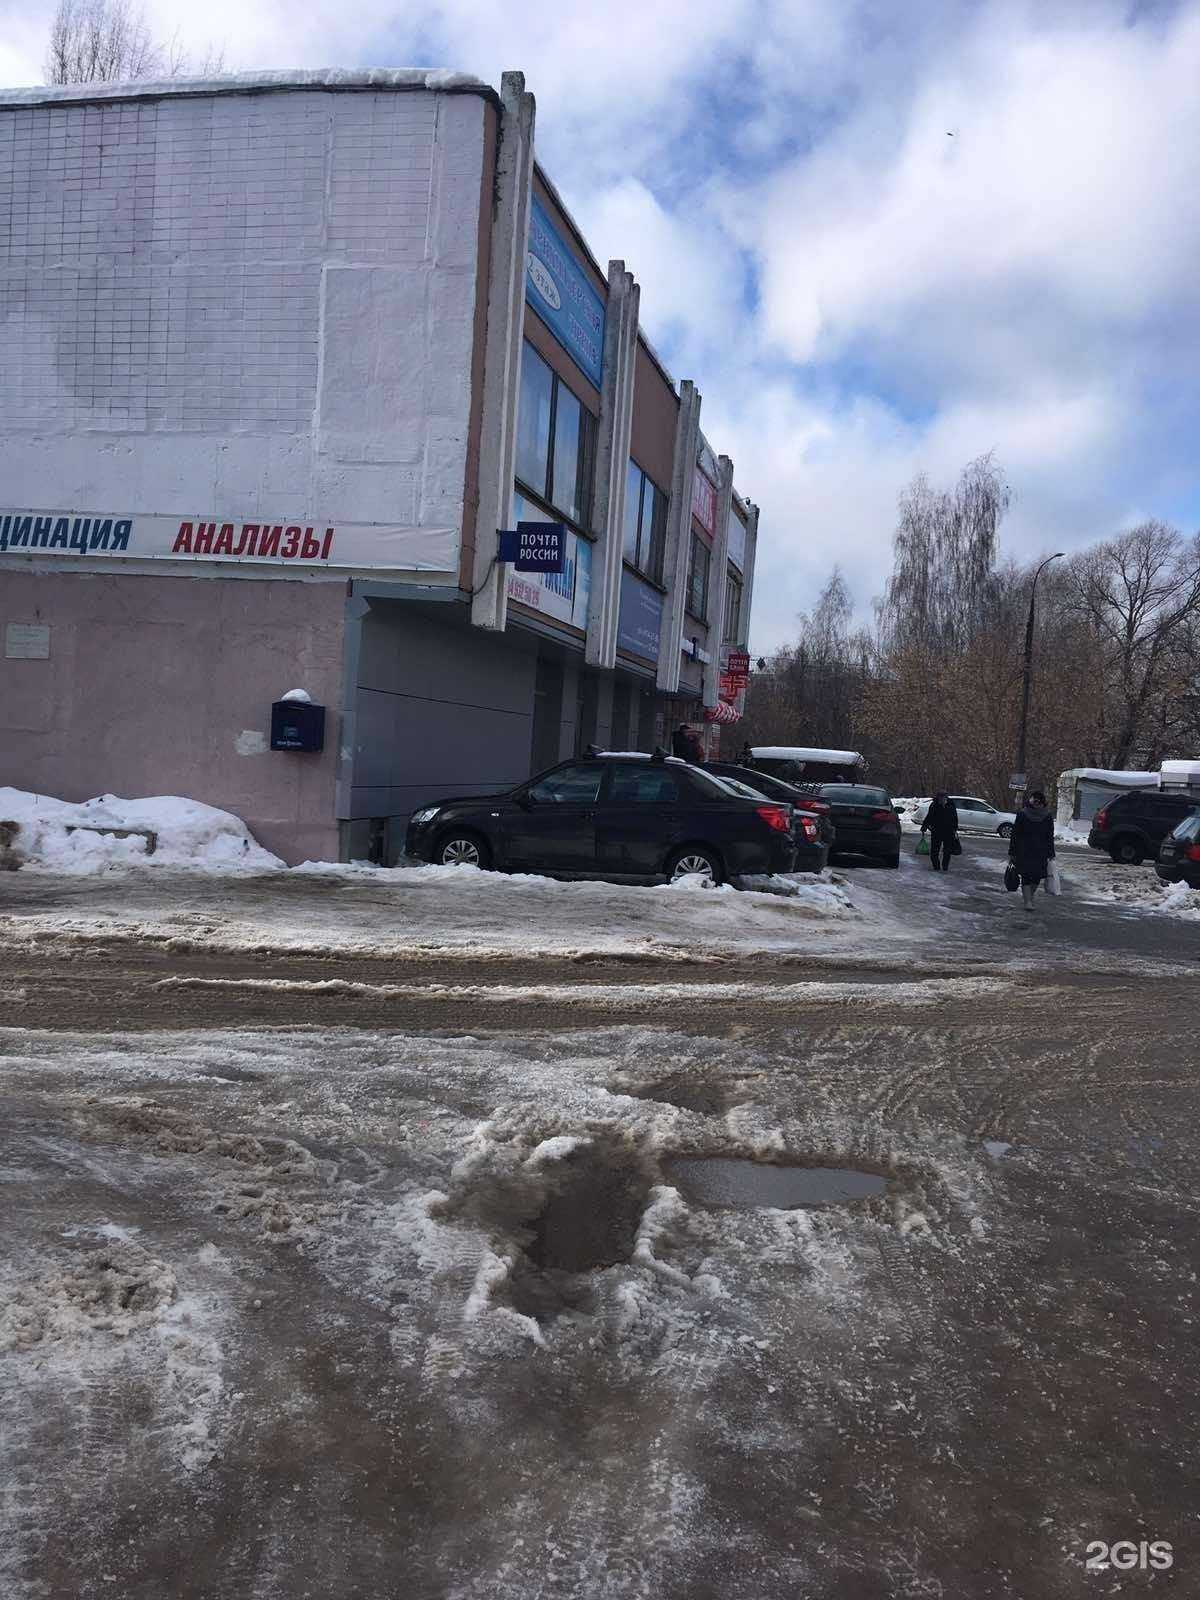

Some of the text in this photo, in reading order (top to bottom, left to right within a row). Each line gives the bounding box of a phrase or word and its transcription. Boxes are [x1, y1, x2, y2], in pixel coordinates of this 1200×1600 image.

[171, 521, 335, 560] АНАЛИЗЫ
[520, 533, 559, 546] ПОЧТА
[519, 548, 559, 561] РОССИИ
